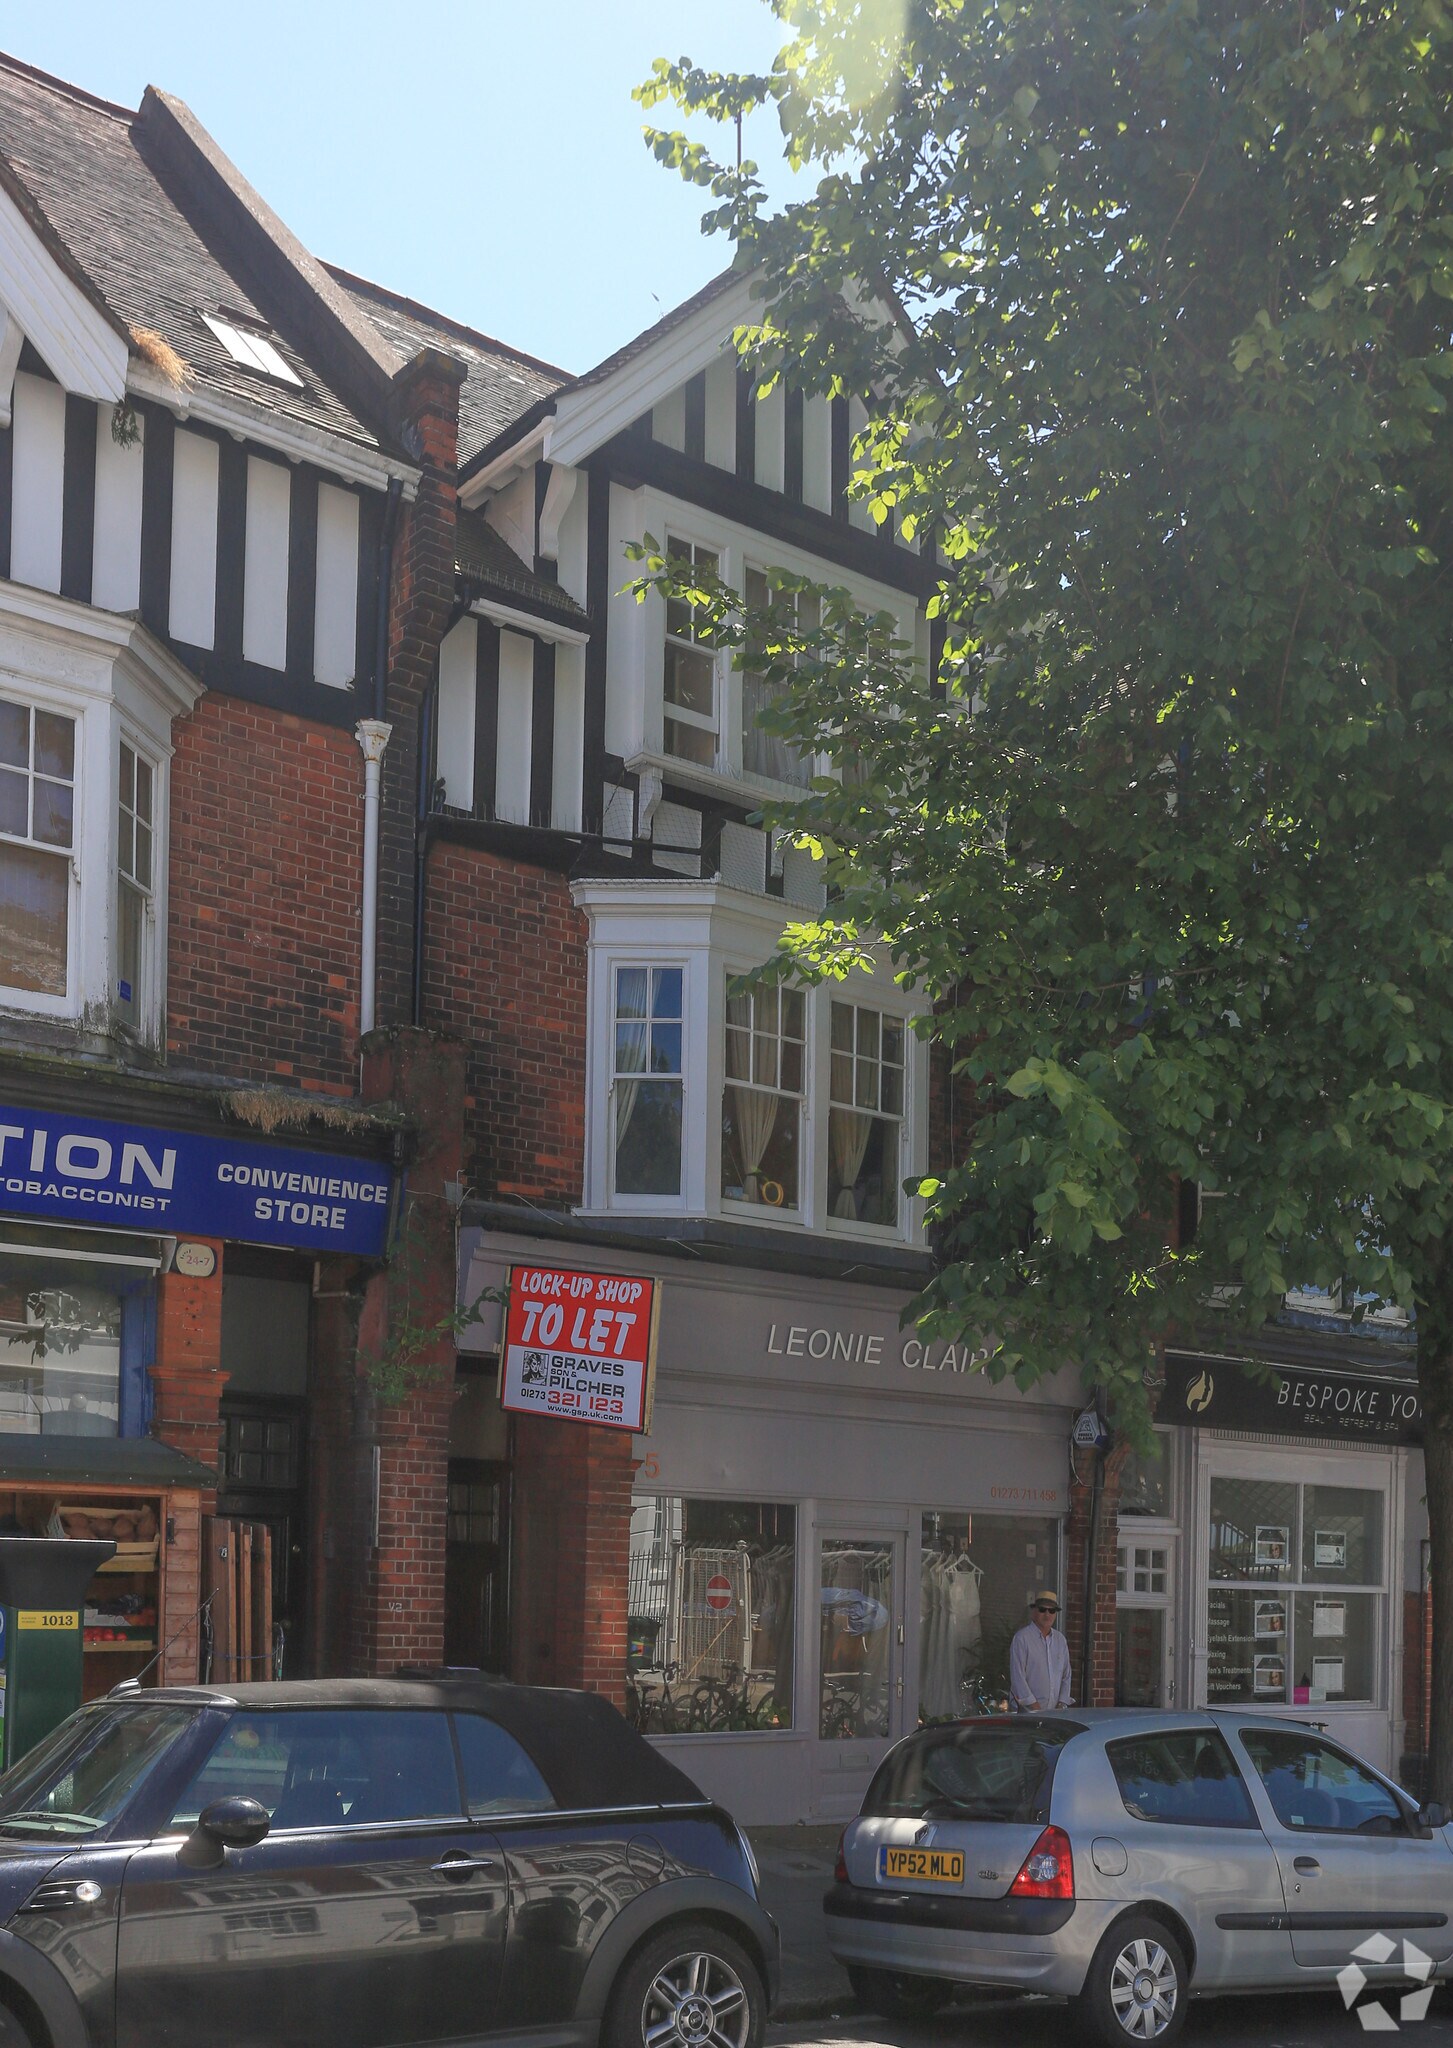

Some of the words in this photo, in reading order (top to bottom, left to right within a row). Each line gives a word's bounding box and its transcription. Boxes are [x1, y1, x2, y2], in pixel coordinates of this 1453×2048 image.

[0, 1178, 171, 1211] OBACCONIST
[217, 1163, 388, 1204] CONVENIENCE
[254, 1197, 347, 1230] STORE
[520, 1271, 593, 1299] LOCK-UP
[595, 1279, 643, 1304] SHOP
[521, 1301, 564, 1345] TO
[570, 1307, 637, 1355] LET
[767, 1324, 885, 1365] LEONIE
[902, 1339, 997, 1375] CLAIR
[550, 1368, 570, 1377] SON
[551, 1355, 624, 1377] GRAVES
[549, 1375, 625, 1398] PILCHER
[520, 1388, 546, 1400] 01273
[547, 1390, 581, 1407] 321
[589, 1396, 624, 1414] 123
[1277, 1381, 1379, 1415] BESPOKE
[1390, 1393, 1423, 1419] YO
[547, 1405, 623, 1422] www.gsp.uk.com
[645, 1452, 660, 1478] 5
[41, 1615, 73, 1626] 1013
[889, 1852, 926, 1875] YP52
[930, 1856, 961, 1877] MLO
